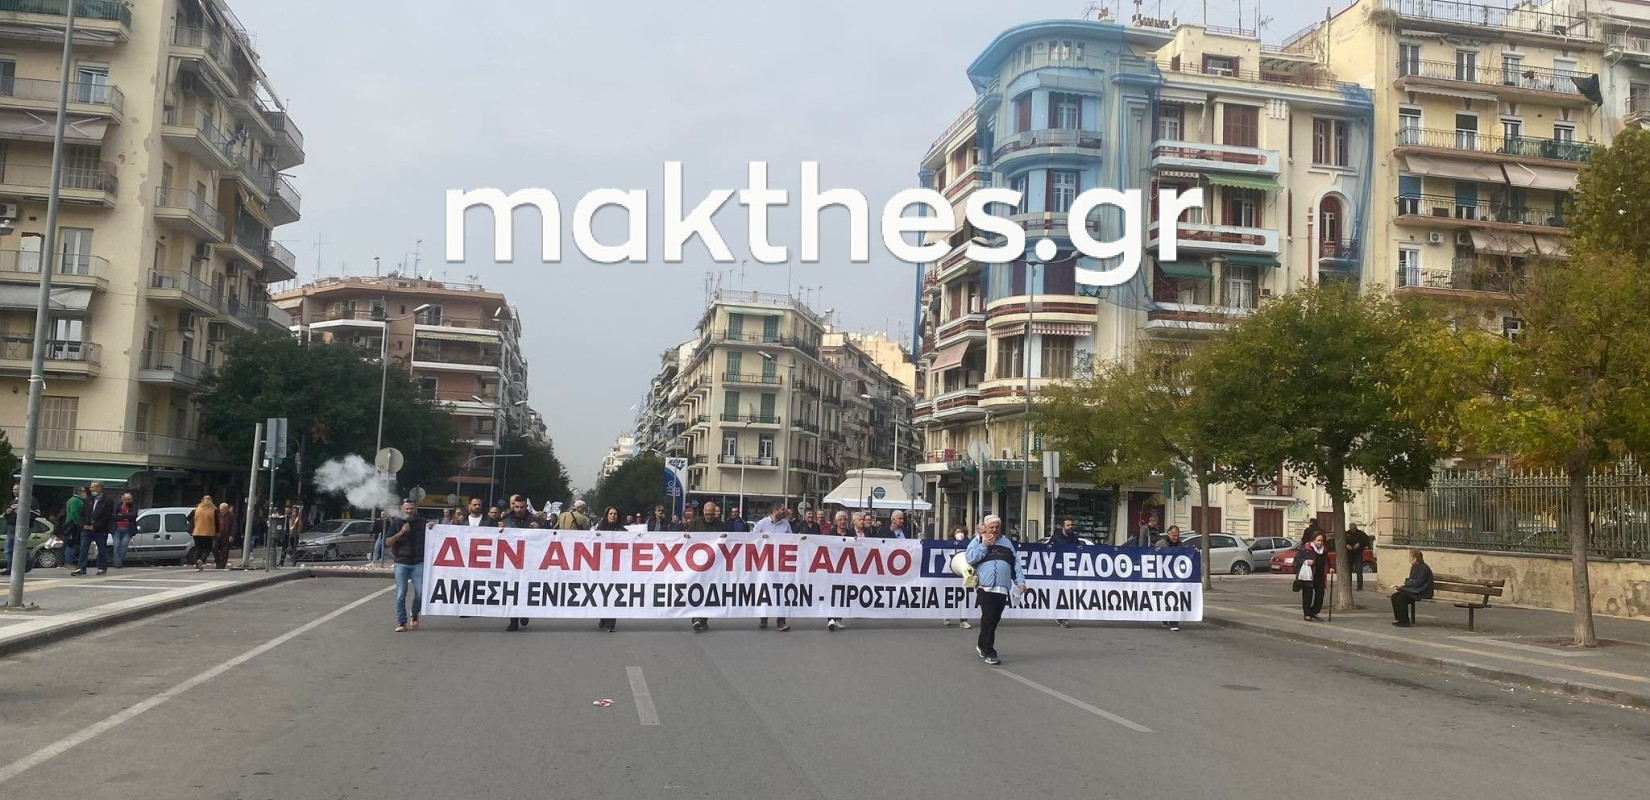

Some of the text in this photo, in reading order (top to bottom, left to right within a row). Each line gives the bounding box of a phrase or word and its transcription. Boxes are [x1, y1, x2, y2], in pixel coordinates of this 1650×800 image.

[433, 536, 912, 577] ΔΕΝ ΑΝΤΕΧΟΥΜΕ ΑΛΛΟ
[430, 578, 519, 607] ΑΜΕΣΗ
[527, 581, 645, 609] ΕΝΙΣΧΥΣΗ
[652, 582, 813, 609] ΕΙΣΟΔΗΜΑΤΩΝ
[830, 584, 940, 609] ΠΡΟΣΤΑΣΙΑ
[1055, 588, 1193, 613] ΔΙΚΑΙΩΜΑΤΩΝ
